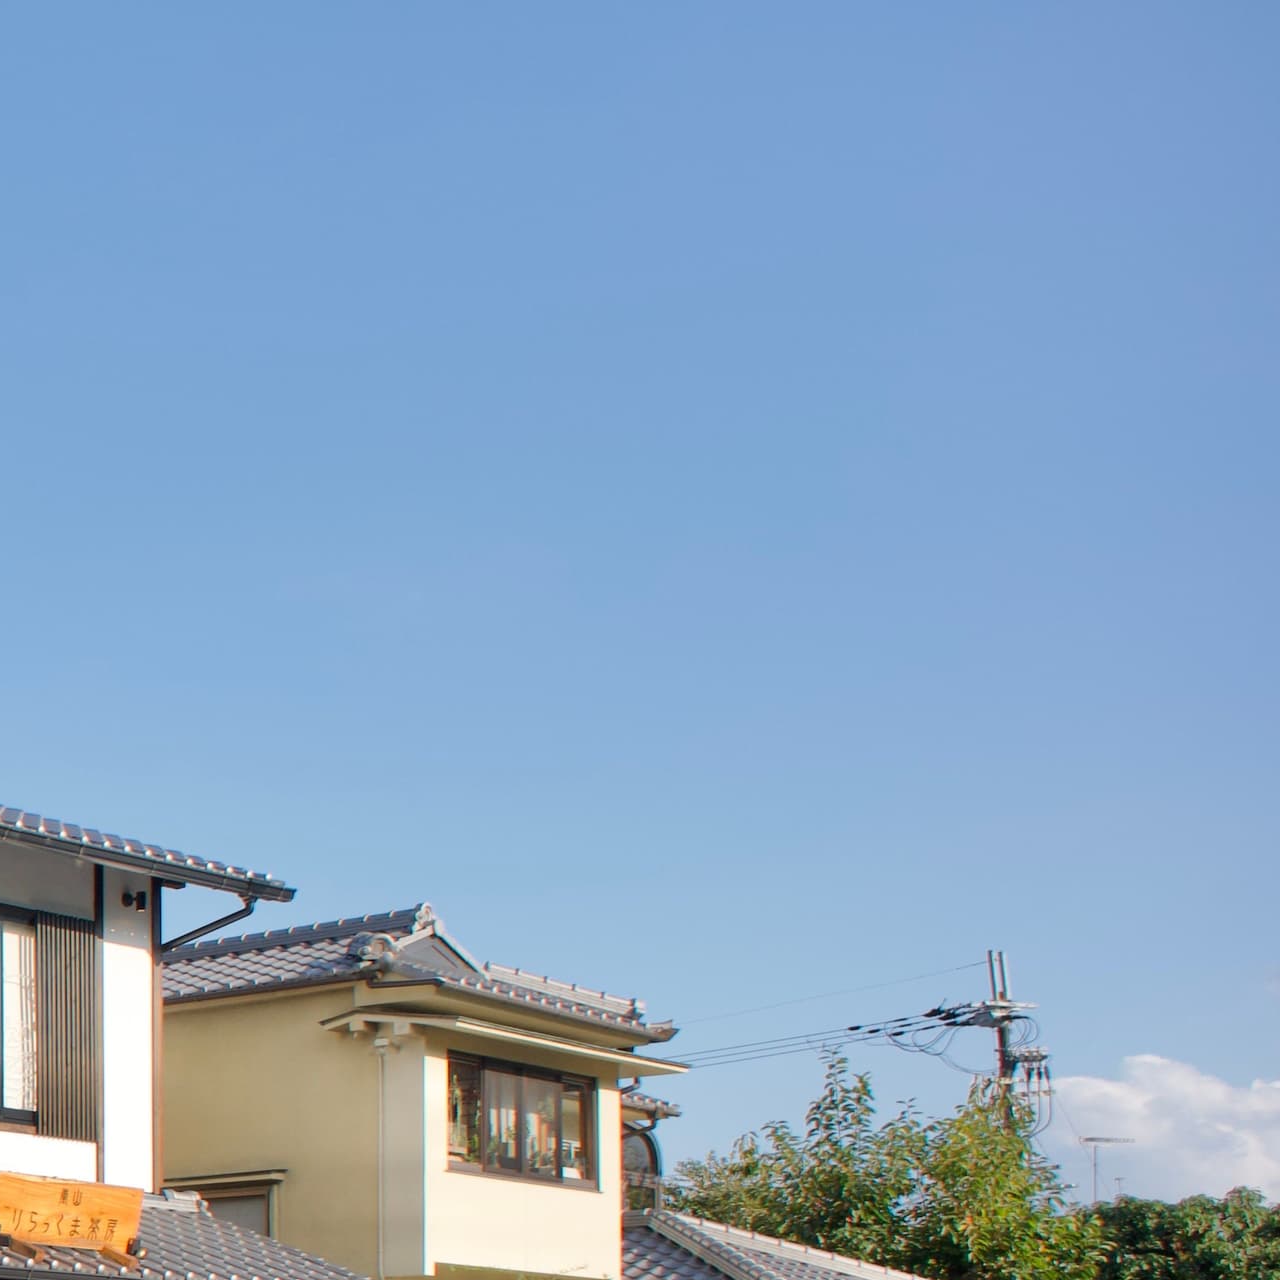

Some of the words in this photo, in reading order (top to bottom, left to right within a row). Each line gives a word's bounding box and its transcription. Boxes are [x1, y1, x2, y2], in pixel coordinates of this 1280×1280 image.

[12, 1209, 118, 1241] りらっくま茶房
